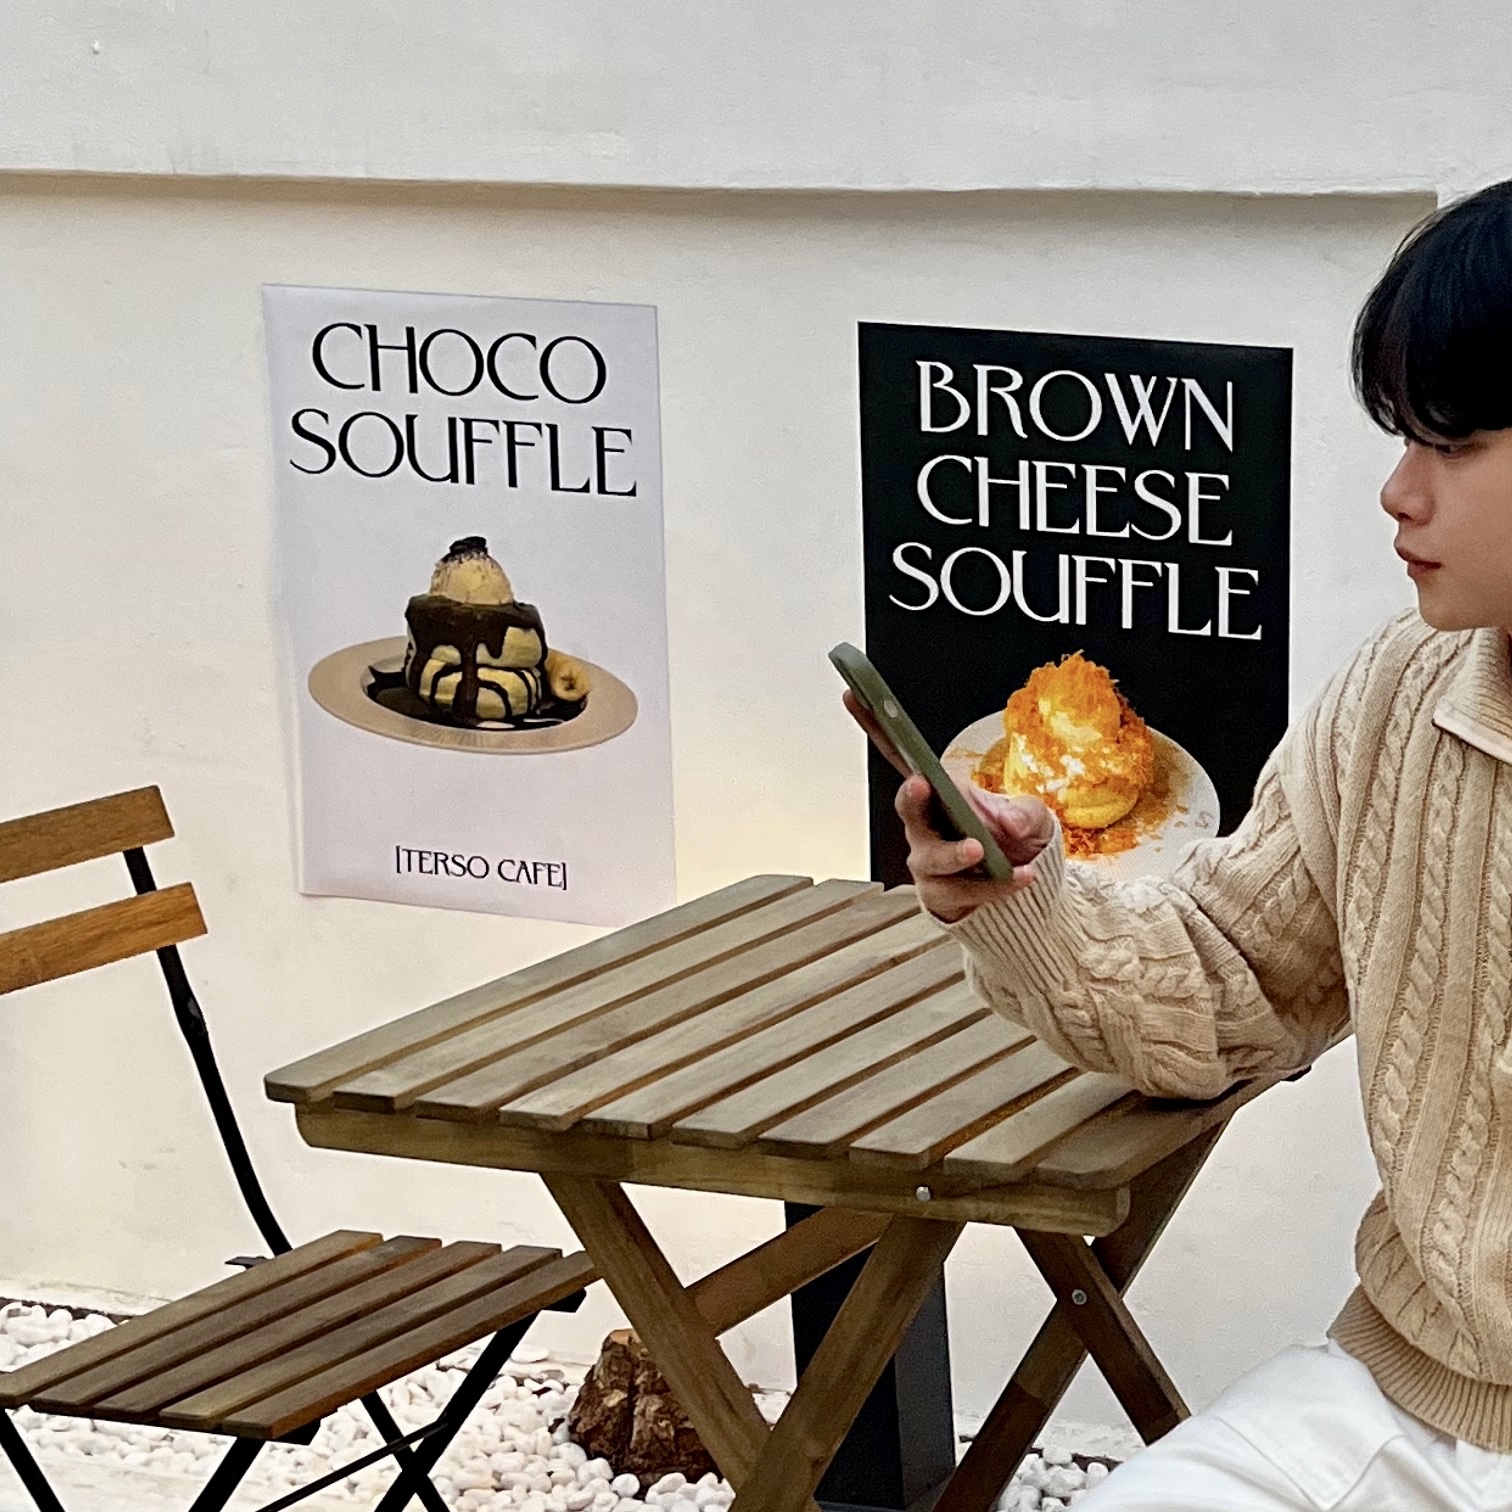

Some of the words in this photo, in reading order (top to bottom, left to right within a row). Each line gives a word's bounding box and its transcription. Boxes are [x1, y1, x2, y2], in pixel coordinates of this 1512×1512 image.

[312, 322, 607, 405] CHOCO
[915, 360, 1233, 453] BROWN
[289, 408, 637, 498] SOUFFLE
[917, 454, 1233, 547] CHEESE
[888, 541, 1262, 641] SOUFFLE
[395, 845, 490, 879] [TERSO
[497, 859, 568, 891] CAFE]
